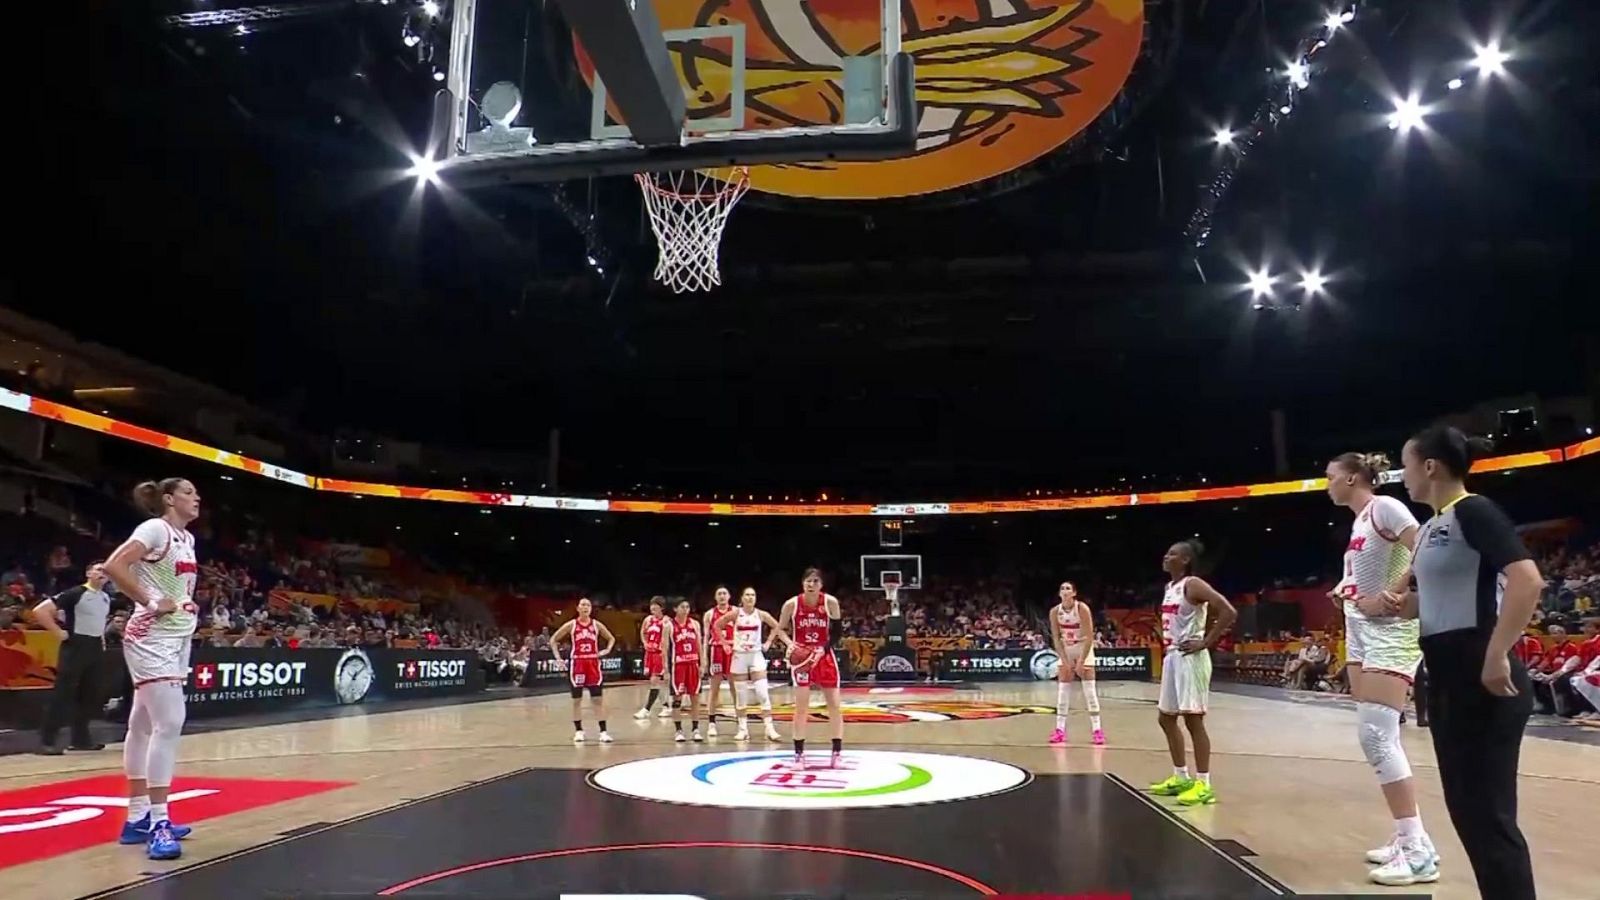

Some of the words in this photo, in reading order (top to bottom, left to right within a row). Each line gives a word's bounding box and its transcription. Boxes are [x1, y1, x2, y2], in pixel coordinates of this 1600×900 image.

[580, 643, 592, 653] 23
[972, 657, 1022, 668] TISSOT
[1094, 656, 1146, 667] TISSOT
[217, 661, 306, 687] TISSOT
[418, 660, 466, 677] TISSOT
[210, 690, 254, 700] WATCHES
[258, 688, 283, 698] SINCE
